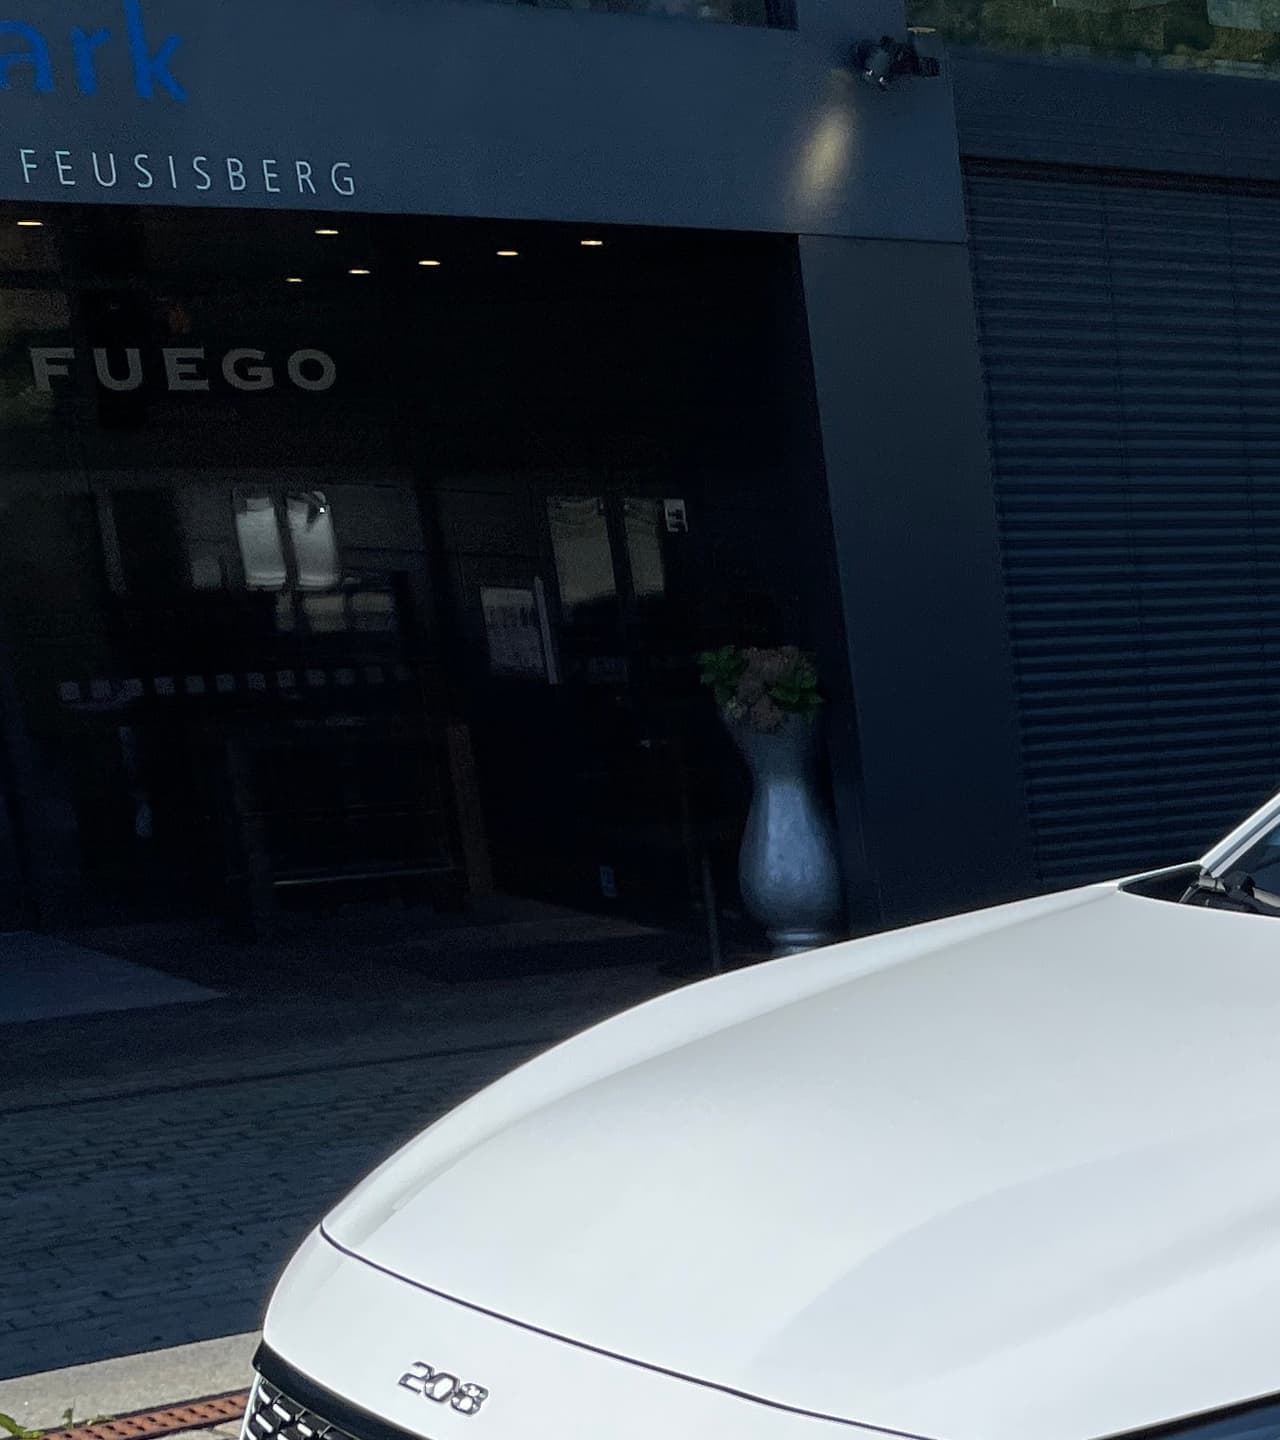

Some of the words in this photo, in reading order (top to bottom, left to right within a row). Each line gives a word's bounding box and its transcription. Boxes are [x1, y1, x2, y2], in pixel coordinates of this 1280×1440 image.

[19, 148, 356, 196] FEUSISBERG
[28, 346, 337, 392] FUEGO
[397, 1360, 489, 1416] 208
